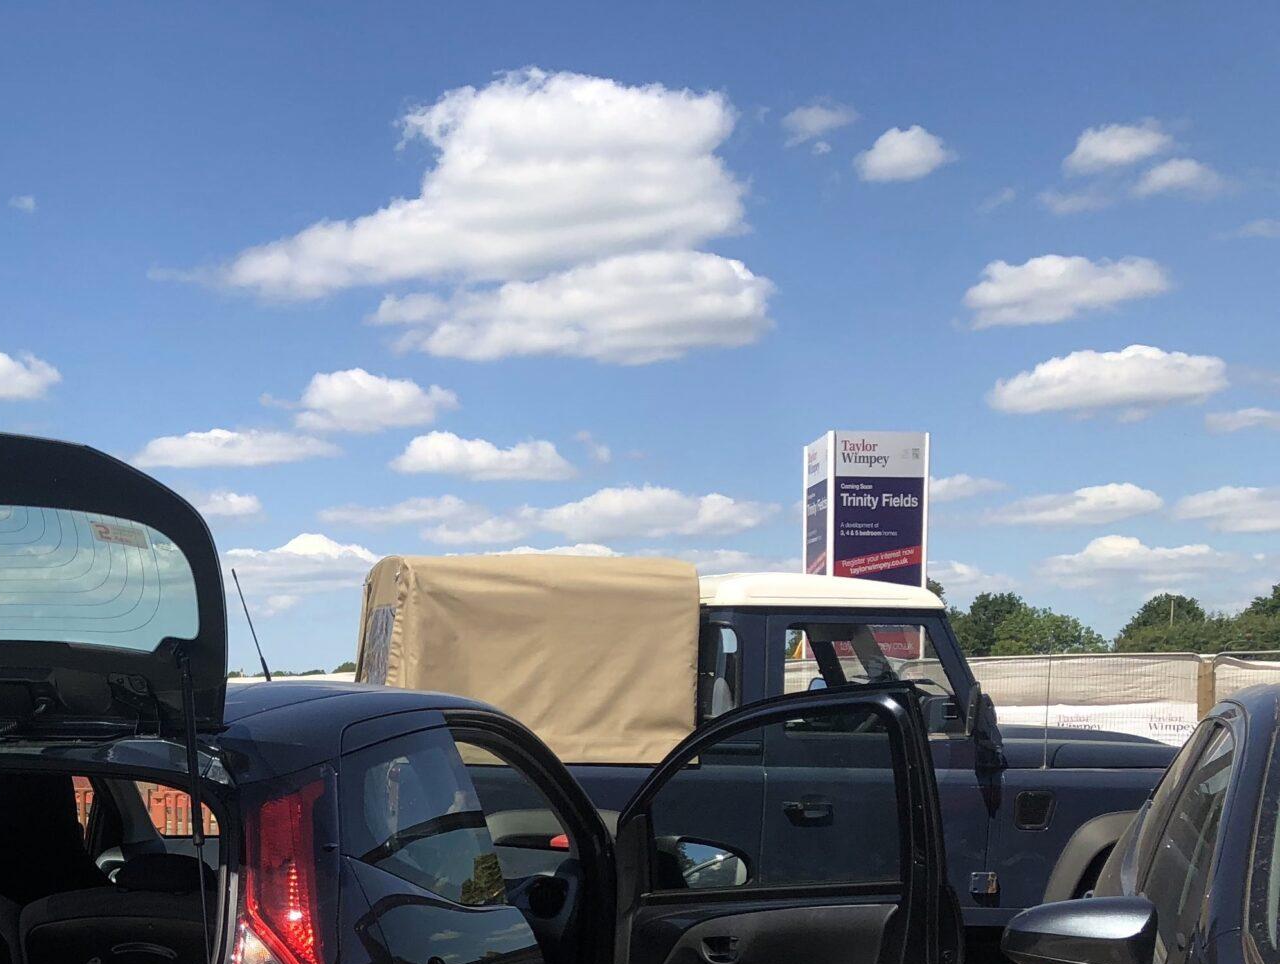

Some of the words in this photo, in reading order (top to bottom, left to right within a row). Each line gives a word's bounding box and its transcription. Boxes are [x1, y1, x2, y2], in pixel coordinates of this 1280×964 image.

[841, 439, 878, 453] Taylor
[842, 453, 889, 467] Wimpey
[840, 493, 879, 509] Trinity
[882, 493, 919, 507] Fields
[842, 557, 866, 568] Register
[867, 555, 880, 564] your
[902, 548, 915, 556] now
[849, 557, 909, 575] taylorwimpey.co.uk
